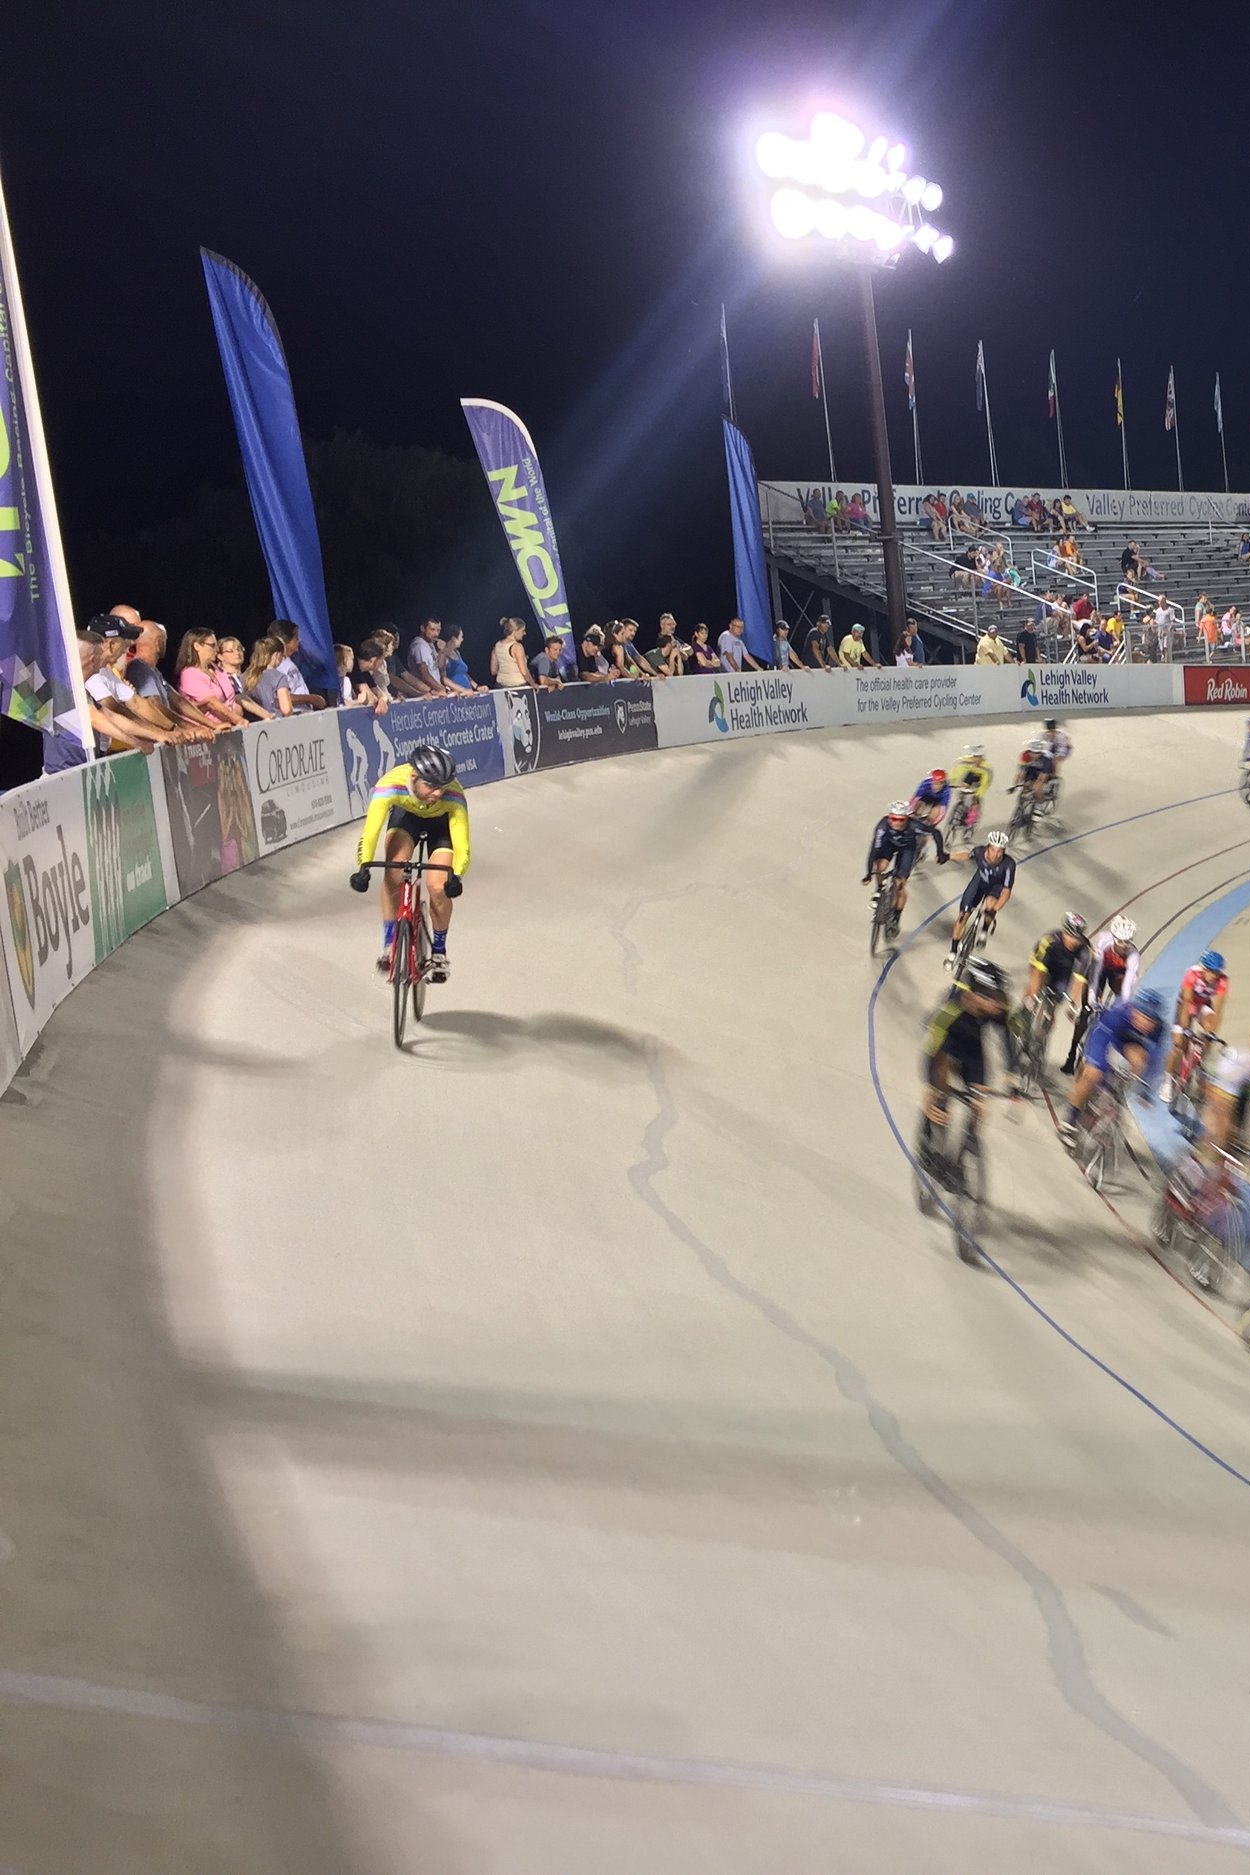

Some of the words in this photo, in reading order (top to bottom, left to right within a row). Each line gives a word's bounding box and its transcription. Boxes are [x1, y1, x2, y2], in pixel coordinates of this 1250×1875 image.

[521, 457, 538, 486] World
[533, 485, 545, 503] the
[1086, 494, 1125, 520] Valley
[1129, 495, 1184, 516] Preferred
[856, 678, 869, 693] The
[870, 677, 892, 692] official
[892, 676, 913, 690] health
[914, 678, 929, 690] care
[930, 674, 957, 691] provider
[1040, 669, 1071, 689] Lehigh
[1070, 668, 1098, 689] Valley
[1207, 678, 1224, 701] Red
[1224, 678, 1248, 701] Robin
[728, 679, 763, 706] Lehigh
[763, 678, 793, 702] Valley
[857, 699, 867, 713] for
[867, 698, 880, 712] the
[881, 697, 901, 714] Valley
[902, 695, 932, 710] Preferred
[933, 693, 958, 710] Cycling
[959, 693, 982, 707] Center
[1041, 688, 1071, 706] Health
[1071, 687, 1109, 705] Network
[391, 710, 423, 733] Hercules
[422, 704, 450, 728] Cement
[450, 699, 492, 723] Stockertown
[730, 706, 764, 732] Health
[764, 701, 809, 729] Network
[427, 733, 440, 748] the
[256, 729, 326, 795] CORPORATE
[466, 758, 478, 771] USA
[22, 824, 90, 980] Boyle
